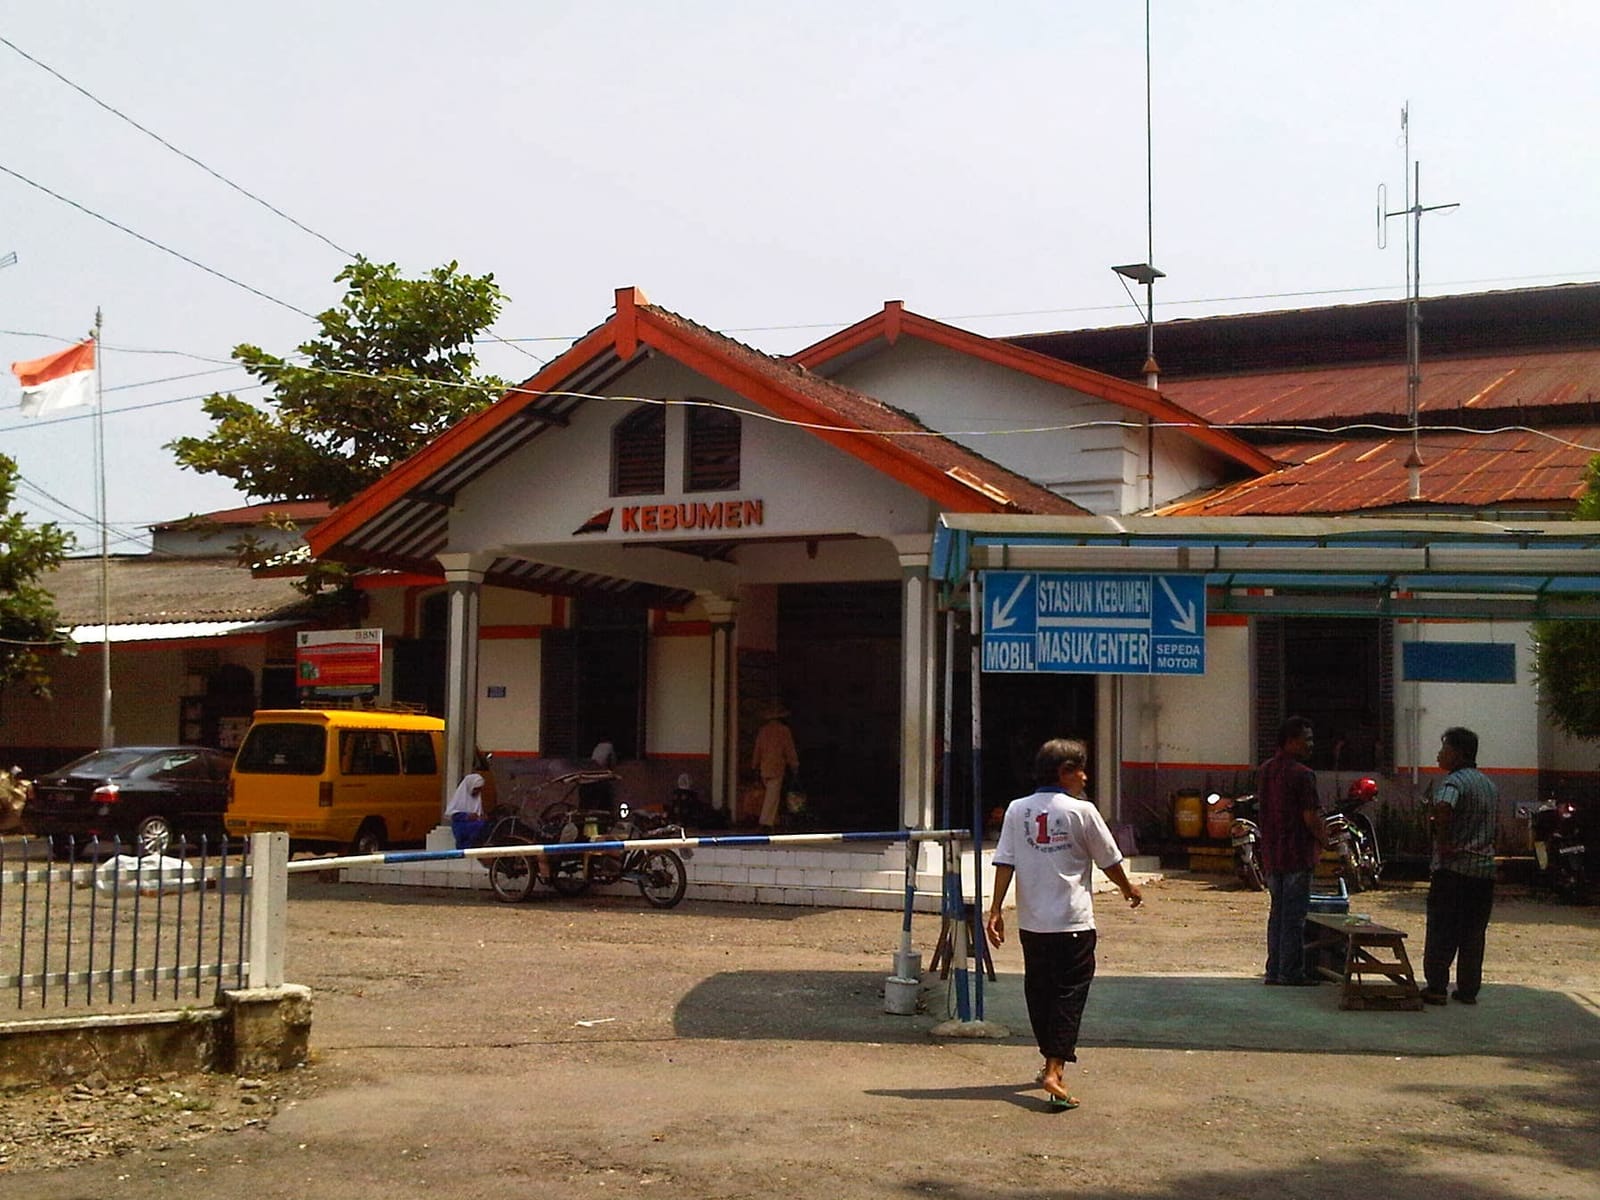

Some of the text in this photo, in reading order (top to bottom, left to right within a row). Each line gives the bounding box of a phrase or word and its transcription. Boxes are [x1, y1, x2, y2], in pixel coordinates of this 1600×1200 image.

[622, 500, 764, 532] KEBUMEN
[1039, 581, 1149, 613] STASIUN KEBUMEN
[987, 642, 1034, 670] MOBIL
[1038, 632, 1149, 665] MASUK/ENTER
[1156, 644, 1201, 656] SEPEDA
[1157, 657, 1198, 669] MOTOR
[1036, 813, 1050, 844] 1
